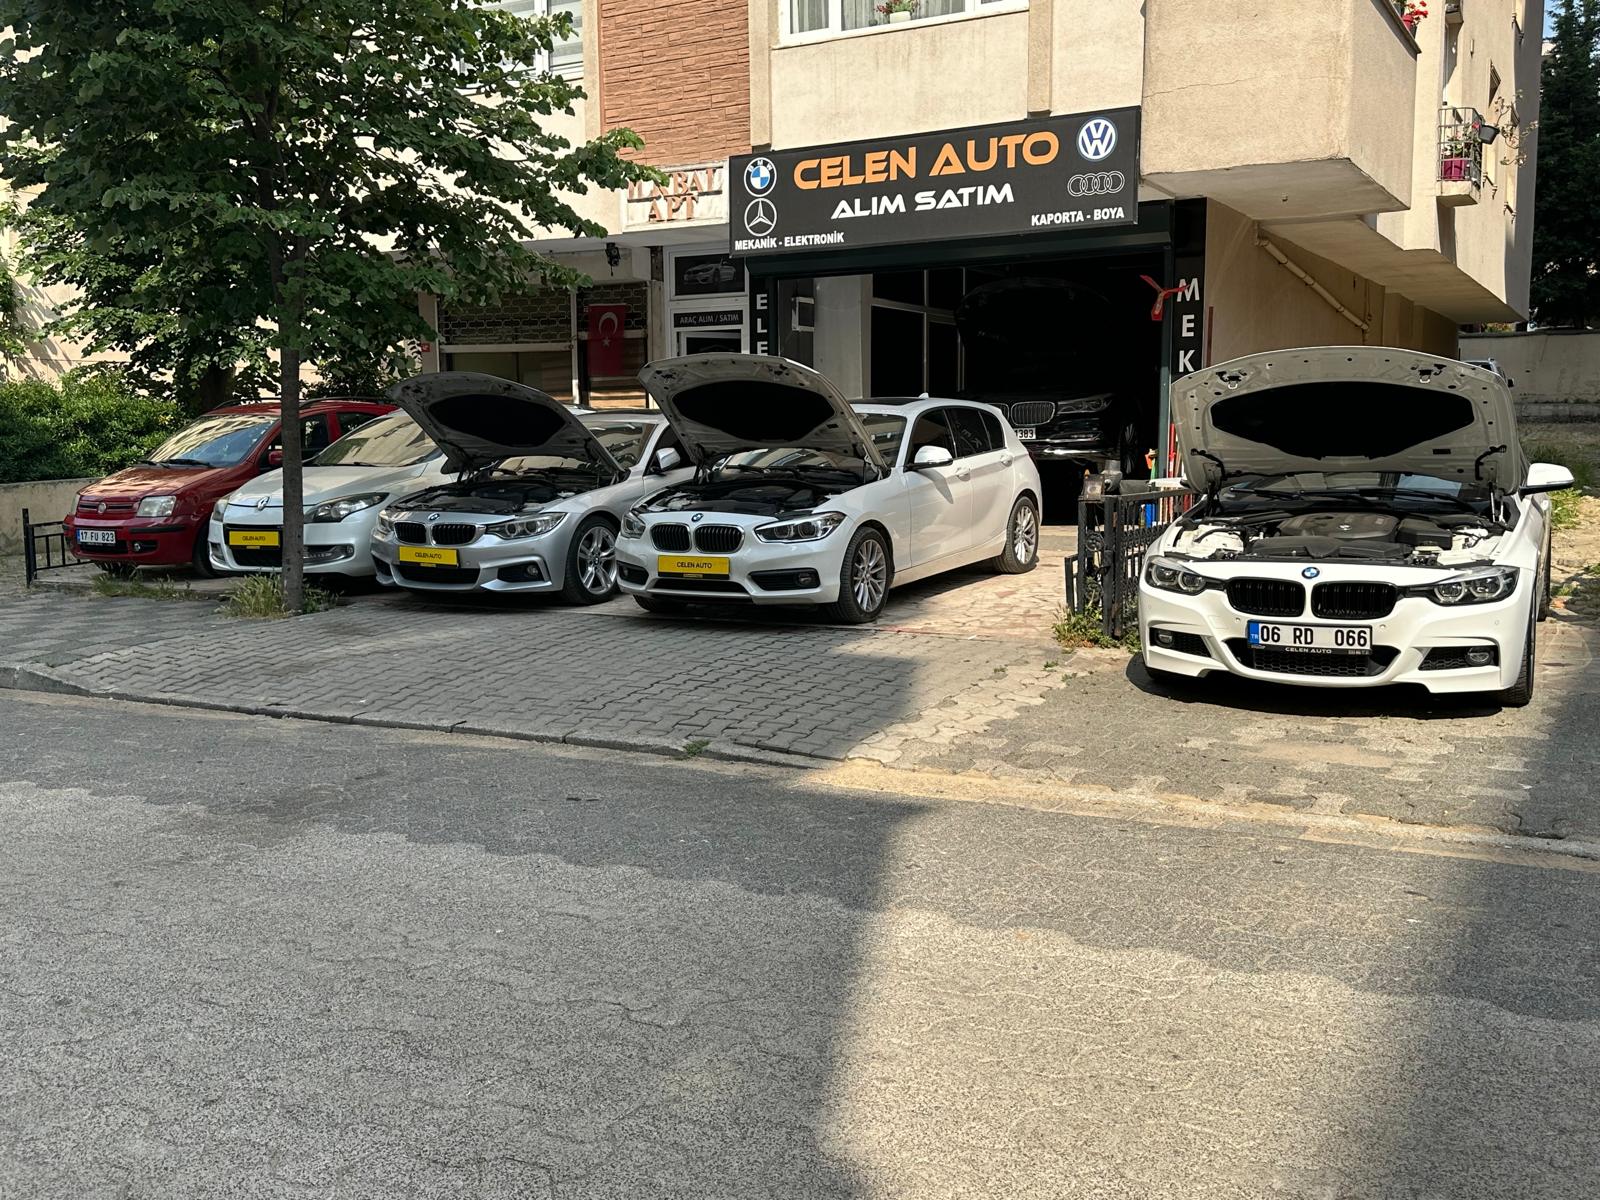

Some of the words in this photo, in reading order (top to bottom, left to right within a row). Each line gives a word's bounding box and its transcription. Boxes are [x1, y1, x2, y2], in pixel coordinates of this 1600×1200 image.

[793, 146, 917, 190] CELEN
[928, 131, 1060, 177] AUTO
[830, 193, 907, 220] ALIM
[914, 183, 1015, 212] SATIM
[1031, 210, 1085, 226] KAPORTA
[1093, 206, 1125, 221] BOYA
[734, 235, 777, 251] MEKANİK
[784, 230, 845, 247] ELEKTRONİK
[698, 315, 714, 323] ALIM
[719, 313, 739, 322] SATIM
[1176, 277, 1201, 373] MEK
[80, 531, 88, 541] 17
[90, 531, 99, 542] FU
[101, 532, 115, 542] 823
[676, 561, 695, 569] CELEN
[1260, 625, 1281, 643] 06
[1293, 627, 1314, 645] RD
[1334, 629, 1368, 647] 066
